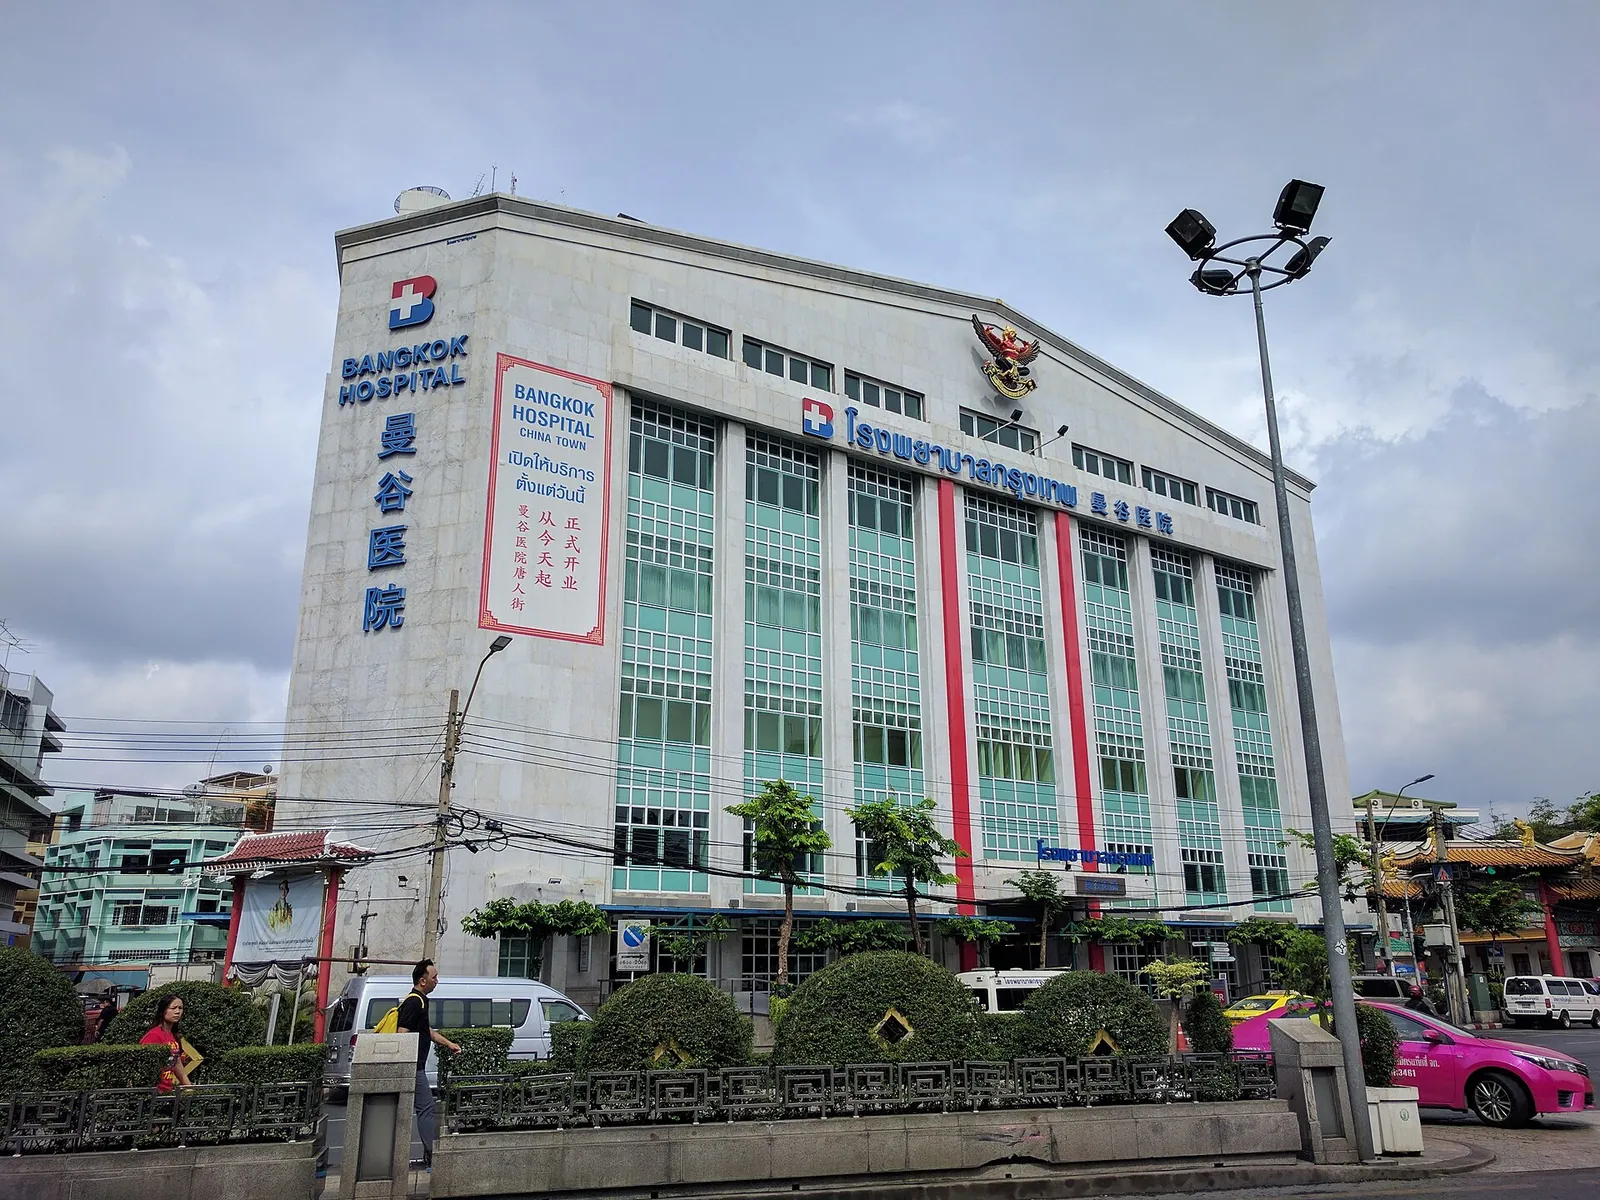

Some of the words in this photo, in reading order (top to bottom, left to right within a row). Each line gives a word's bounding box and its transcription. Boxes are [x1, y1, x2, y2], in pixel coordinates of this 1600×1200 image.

[341, 335, 469, 379] BANGKOK
[338, 363, 466, 406] HOSPITAL
[515, 383, 595, 418] BANGKOK
[513, 405, 595, 438] HOSPITAL
[520, 427, 552, 443] CHINA
[556, 435, 586, 451] TOWN
[508, 450, 595, 482] เปิดให้บริการ
[845, 406, 1078, 508] โรงพยาบาลกรุงเทพ
[516, 472, 586, 504] ตั้งแต่วันนี้
[363, 412, 417, 632] 曼谷医院
[1091, 492, 1173, 535] 曼谷医院
[510, 504, 530, 612] 曼谷医院唐人街
[534, 511, 556, 588] 从今天起
[561, 517, 582, 591] 正式开业
